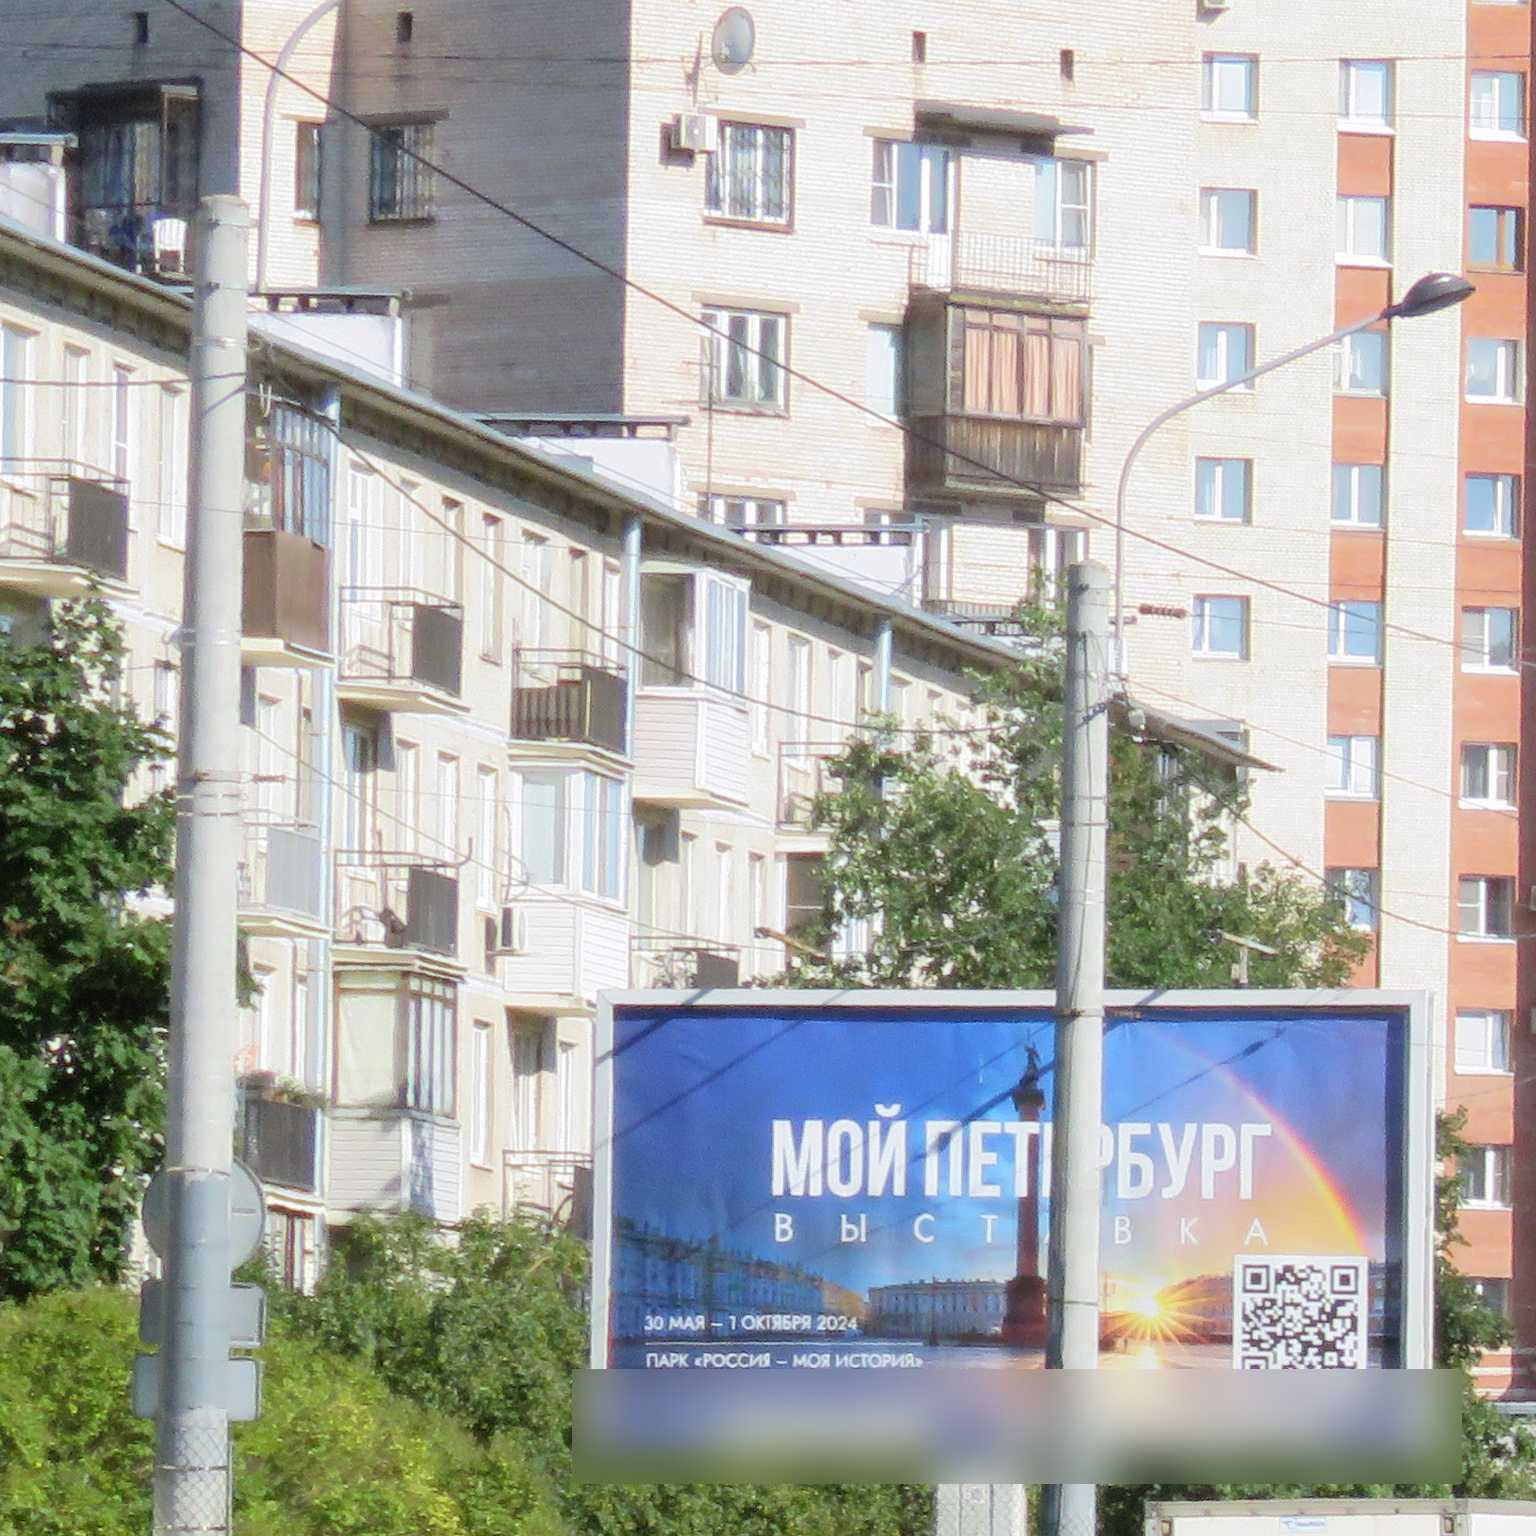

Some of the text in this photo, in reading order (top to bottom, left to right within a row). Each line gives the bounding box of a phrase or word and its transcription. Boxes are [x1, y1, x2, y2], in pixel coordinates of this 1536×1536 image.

[771, 1103, 906, 1198] МОЙ
[774, 1213, 1269, 1246] ВЫСТВКА
[644, 1315, 664, 1331] 30
[668, 1314, 706, 1331] МАЯ
[728, 1314, 738, 1331] 1
[741, 1314, 812, 1331] ОКТЯБРЯ
[816, 1314, 858, 1331] 2024
[646, 1353, 689, 1368] ПАРК
[694, 1352, 771, 1368] «РОССИЯ
[792, 1353, 831, 1368] МОЯ
[835, 1352, 924, 1368] ИСТОРИЯ»
